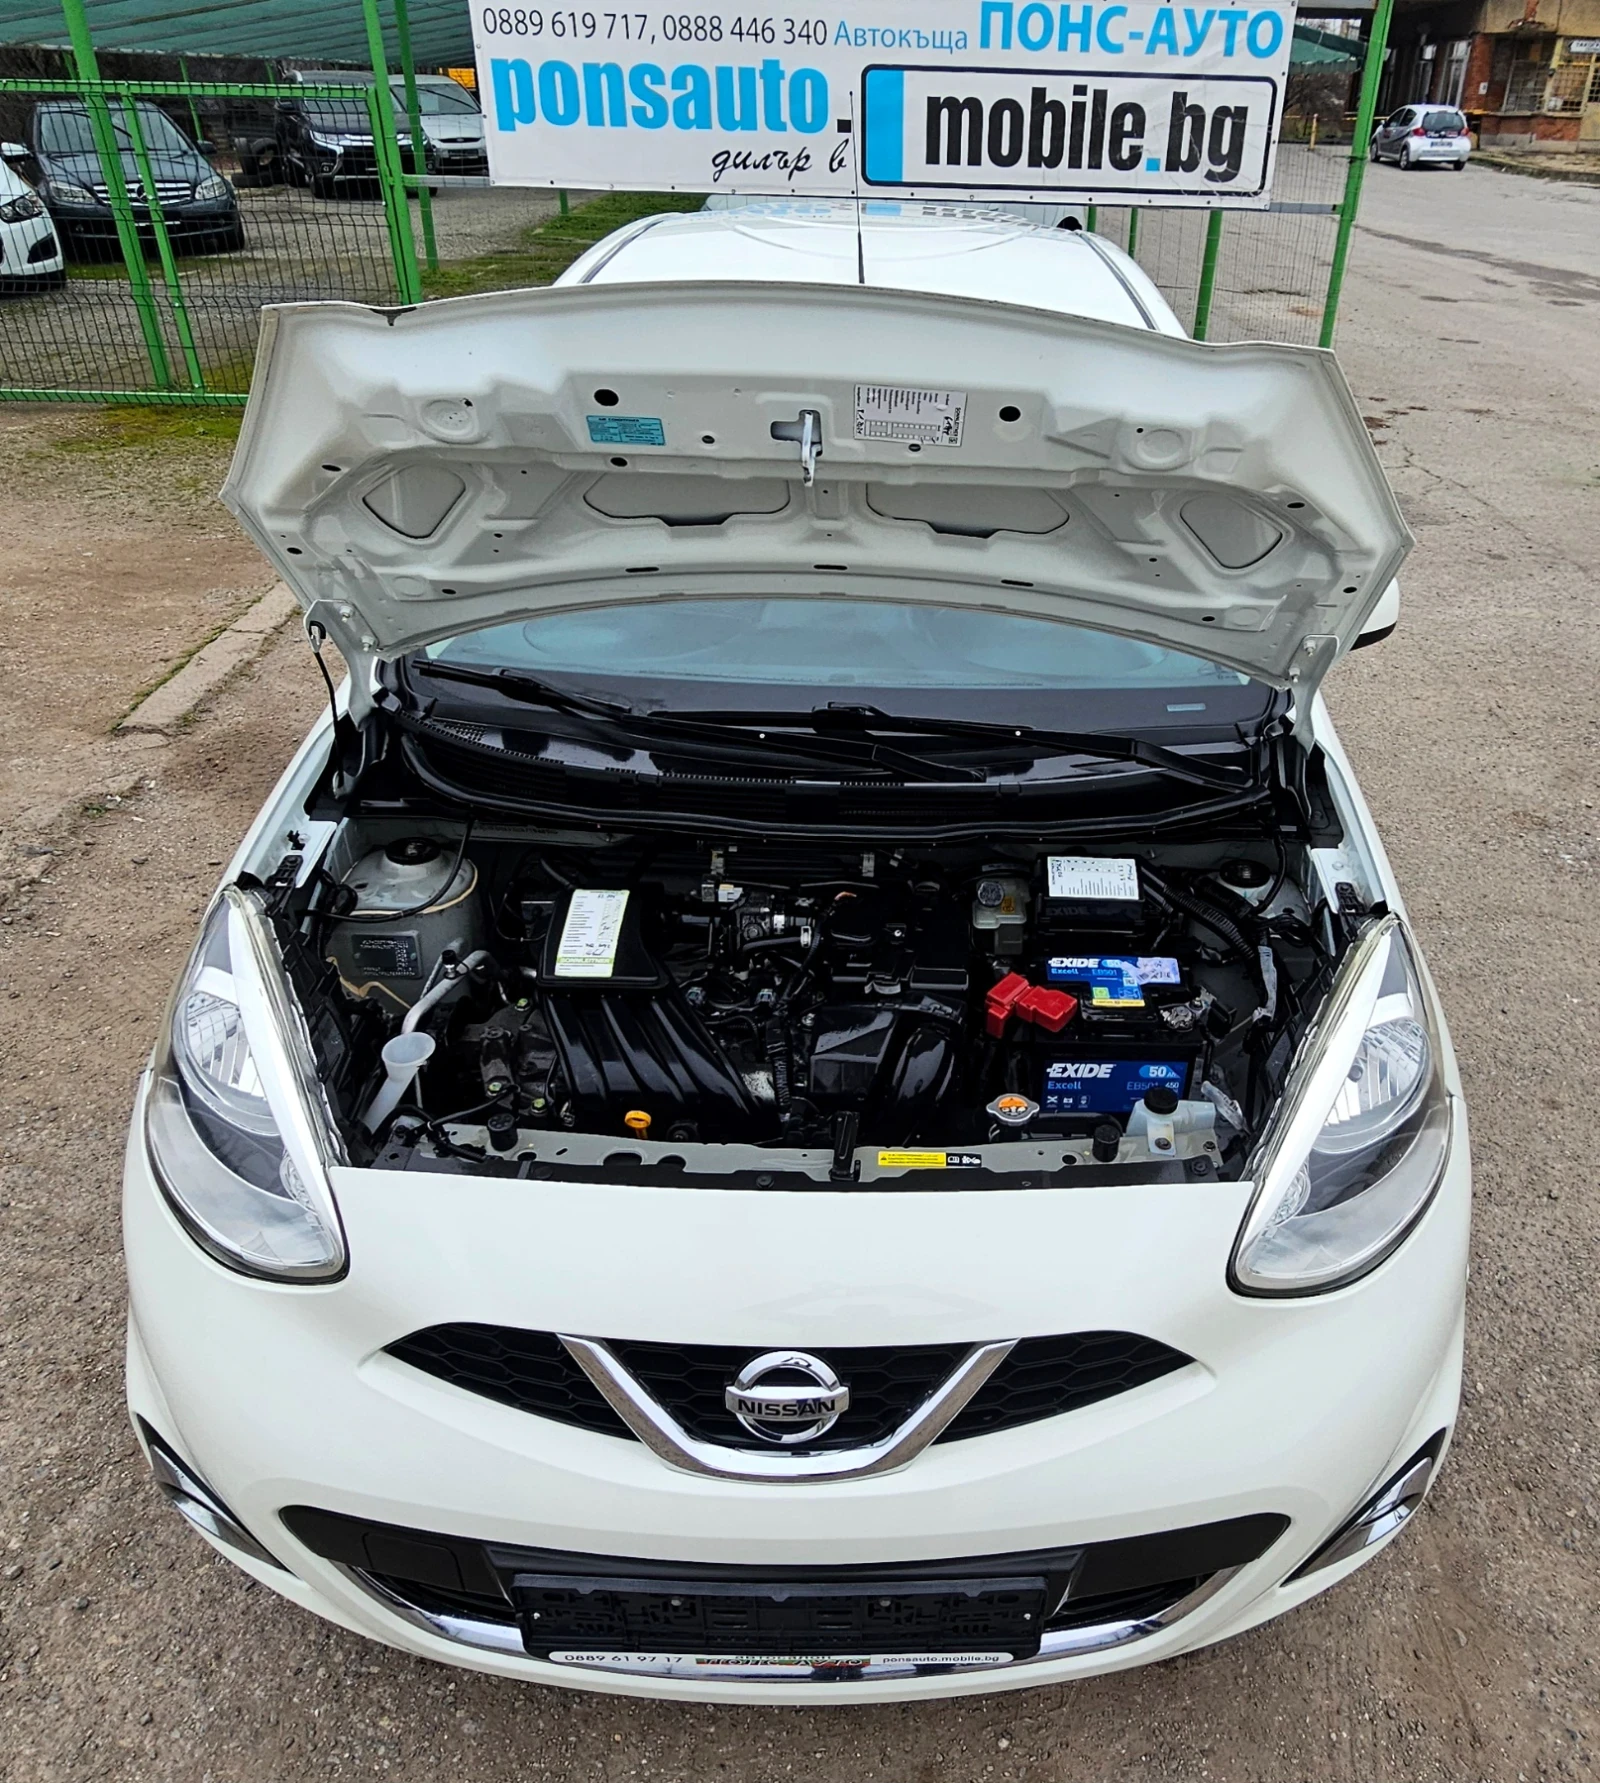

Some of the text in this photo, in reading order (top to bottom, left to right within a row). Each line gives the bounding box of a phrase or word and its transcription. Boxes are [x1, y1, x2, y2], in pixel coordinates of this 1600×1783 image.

[482, 7, 828, 46] 0889 619 717, 0888 446 340
[833, 0, 1285, 60] Автокъща ПОНС-АУТО
[925, 84, 1249, 183] mobile.bg
[711, 138, 850, 182] дилър в
[1047, 957, 1101, 968] EXIDE
[1046, 1063, 1114, 1079] EXIDE
[1149, 1066, 1167, 1077] 50
[1048, 1081, 1082, 1090] Excell
[738, 1398, 836, 1417] NISSAN
[564, 1654, 605, 1662] 0889
[882, 1655, 1000, 1665] ponsauto.mobile.bg
